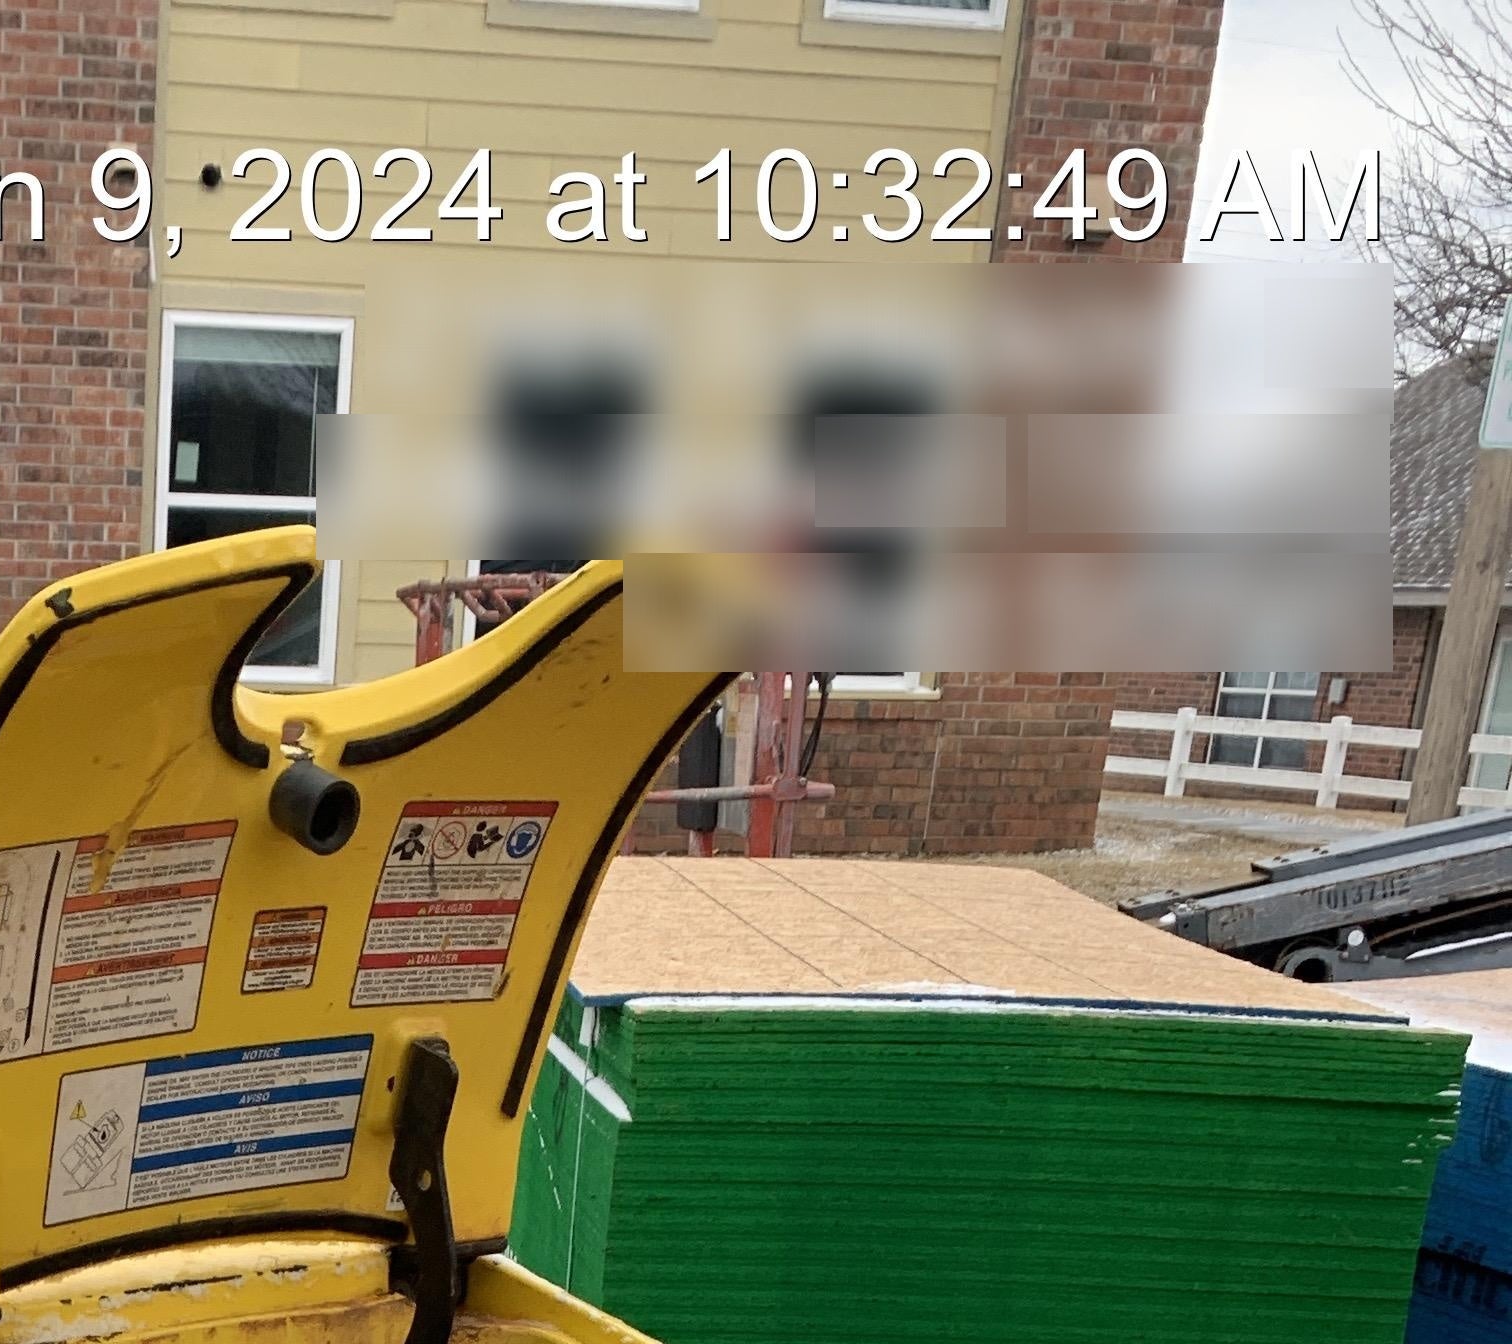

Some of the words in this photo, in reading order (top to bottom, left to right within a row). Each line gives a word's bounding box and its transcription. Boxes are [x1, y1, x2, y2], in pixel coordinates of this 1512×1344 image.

[462, 805, 507, 814] DANGER
[427, 903, 473, 914] PELIGRO
[415, 953, 458, 964] DANGER
[241, 1047, 281, 1061] NOTICE
[238, 1092, 270, 1104] AVISO
[234, 1143, 258, 1154] AVIS
